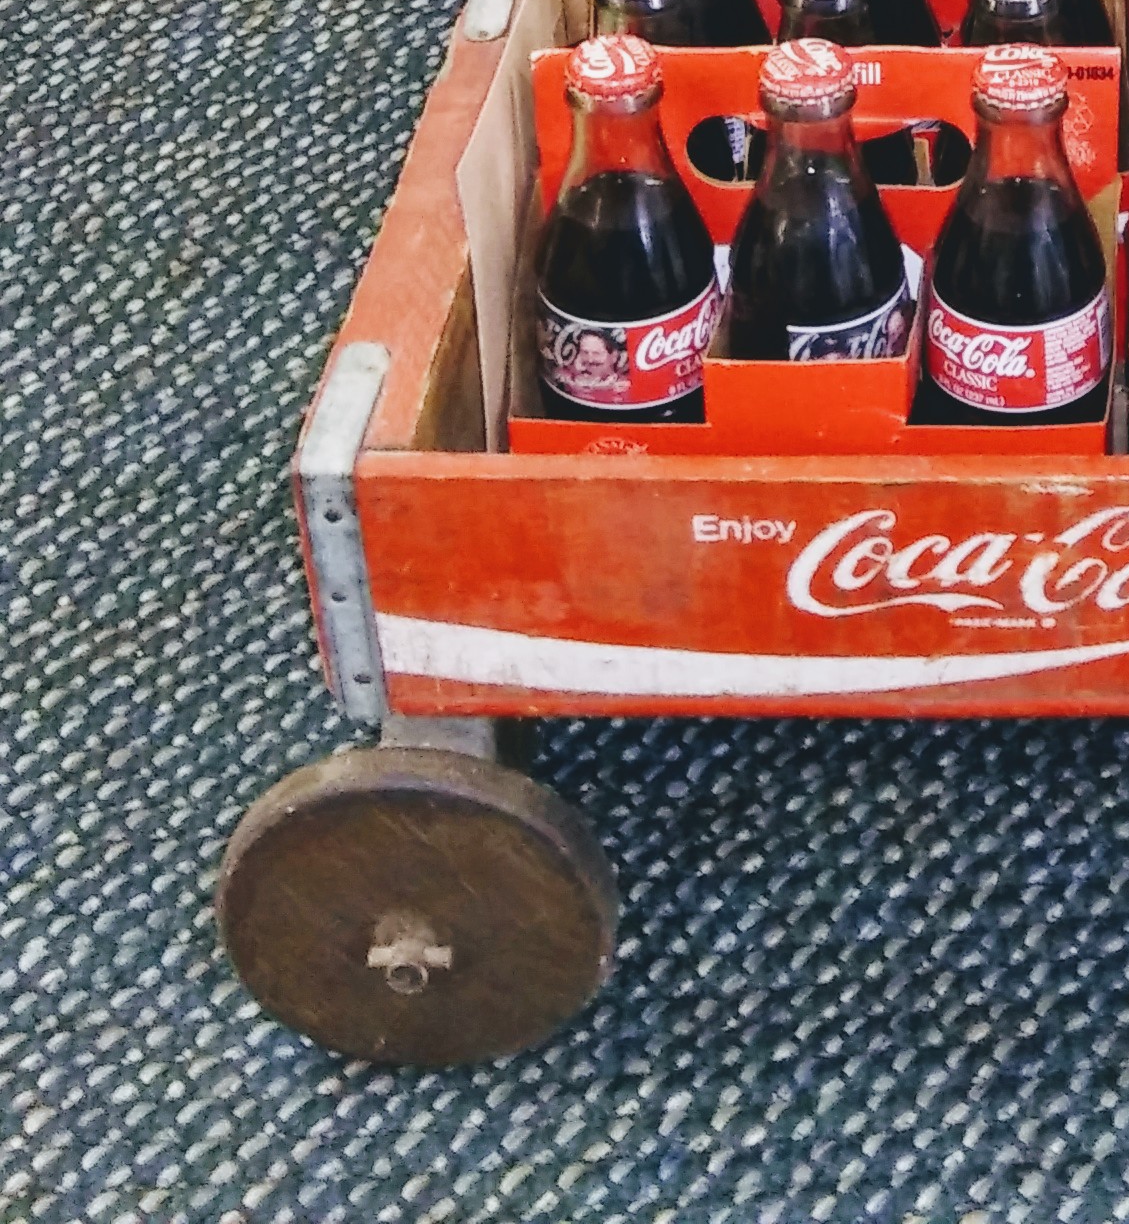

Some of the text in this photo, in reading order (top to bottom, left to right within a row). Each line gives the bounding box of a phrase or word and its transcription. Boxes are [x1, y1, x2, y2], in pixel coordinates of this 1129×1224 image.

[928, 308, 1032, 377] Coca-Cola
[943, 359, 998, 392] CLASSIC
[692, 514, 797, 545] Enjoy
